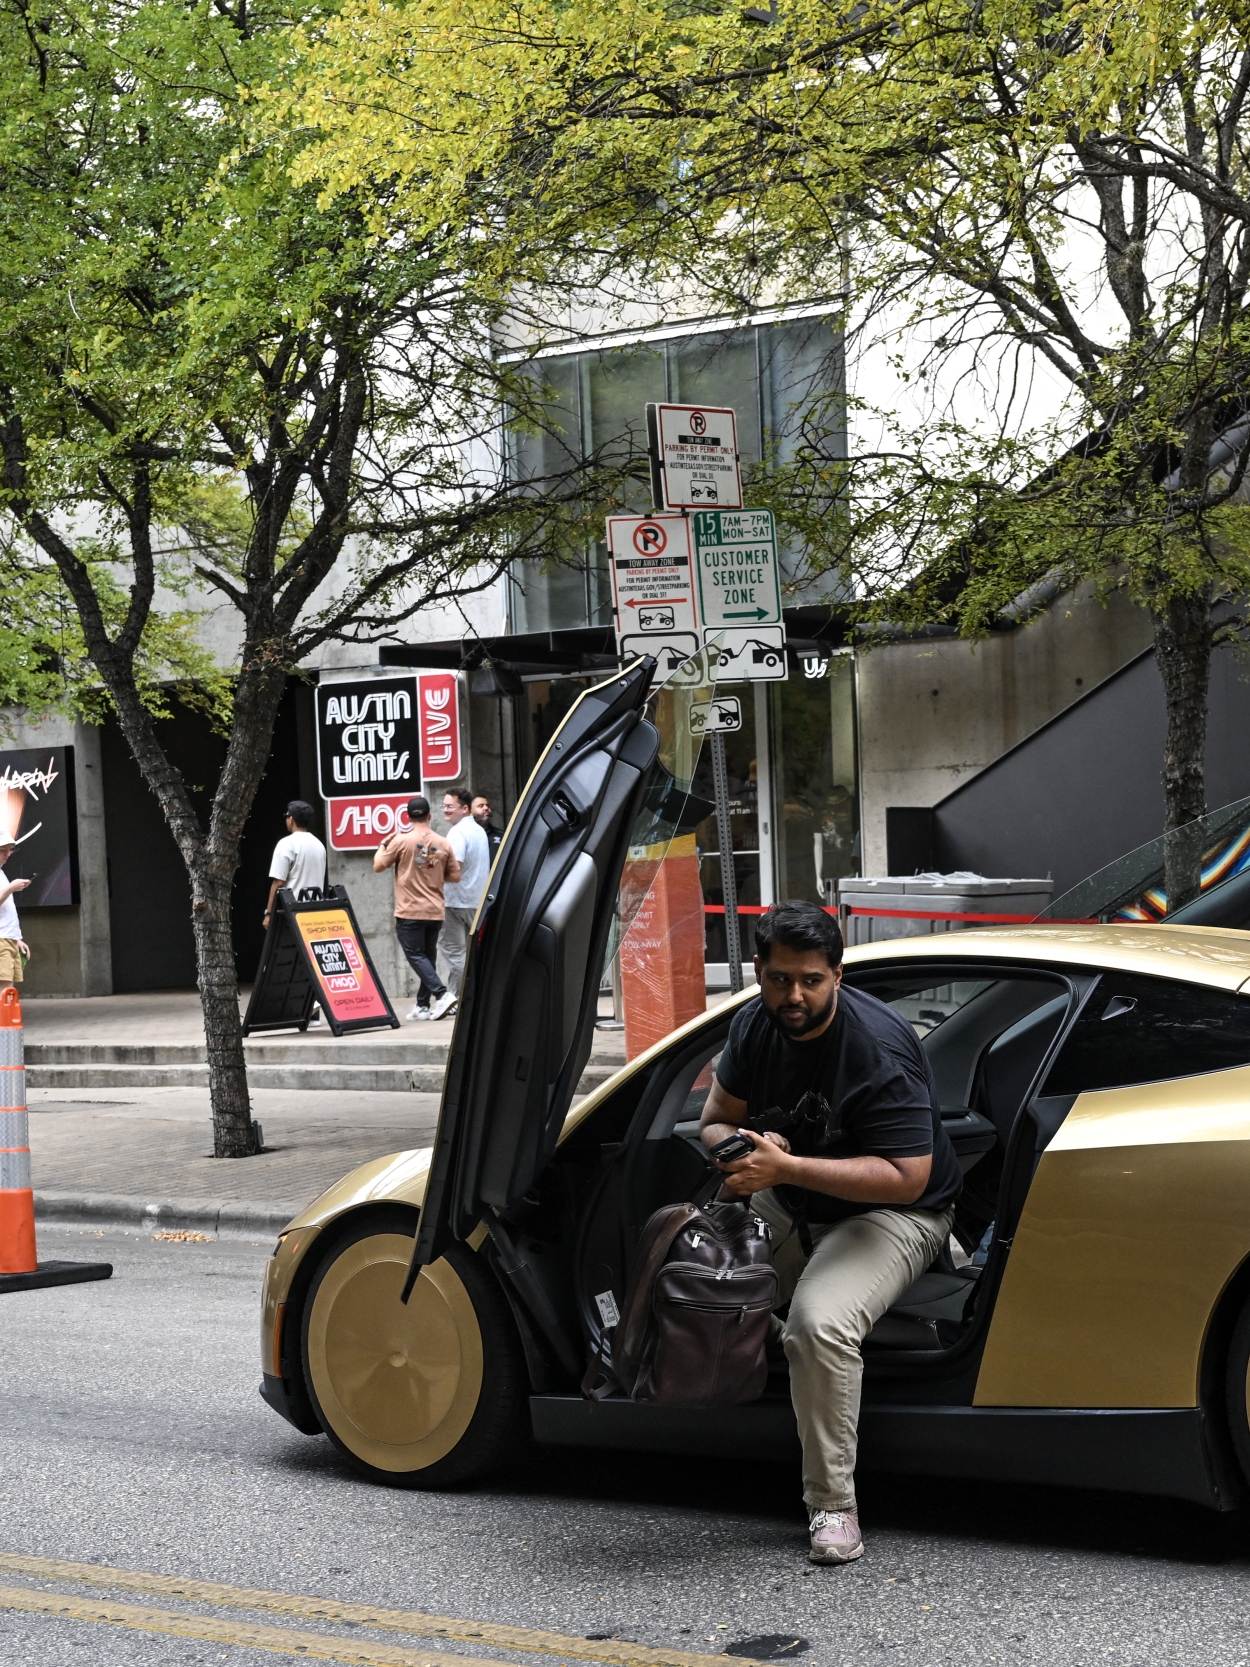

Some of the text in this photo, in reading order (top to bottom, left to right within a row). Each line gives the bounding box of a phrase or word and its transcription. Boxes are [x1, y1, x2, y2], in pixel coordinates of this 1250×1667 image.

[665, 444, 734, 455] PARKING BY PERMIT ONLY
[701, 455, 725, 463] INFORMATION
[698, 512, 716, 534] 15
[699, 534, 717, 546] MIN
[629, 558, 675, 568] TOW AWAY ZONE
[704, 549, 769, 567] CUSTOMER
[713, 569, 764, 586] SERVICE
[724, 588, 756, 605] ZONE
[326, 690, 411, 725] AUSTIN
[341, 721, 395, 753] CITY
[631, 921, 650, 929] ONLY
[314, 942, 342, 955] AUSTIN
[322, 953, 340, 963] CITY
[330, 977, 356, 989] SHOP
[334, 998, 354, 1006] OPEN
